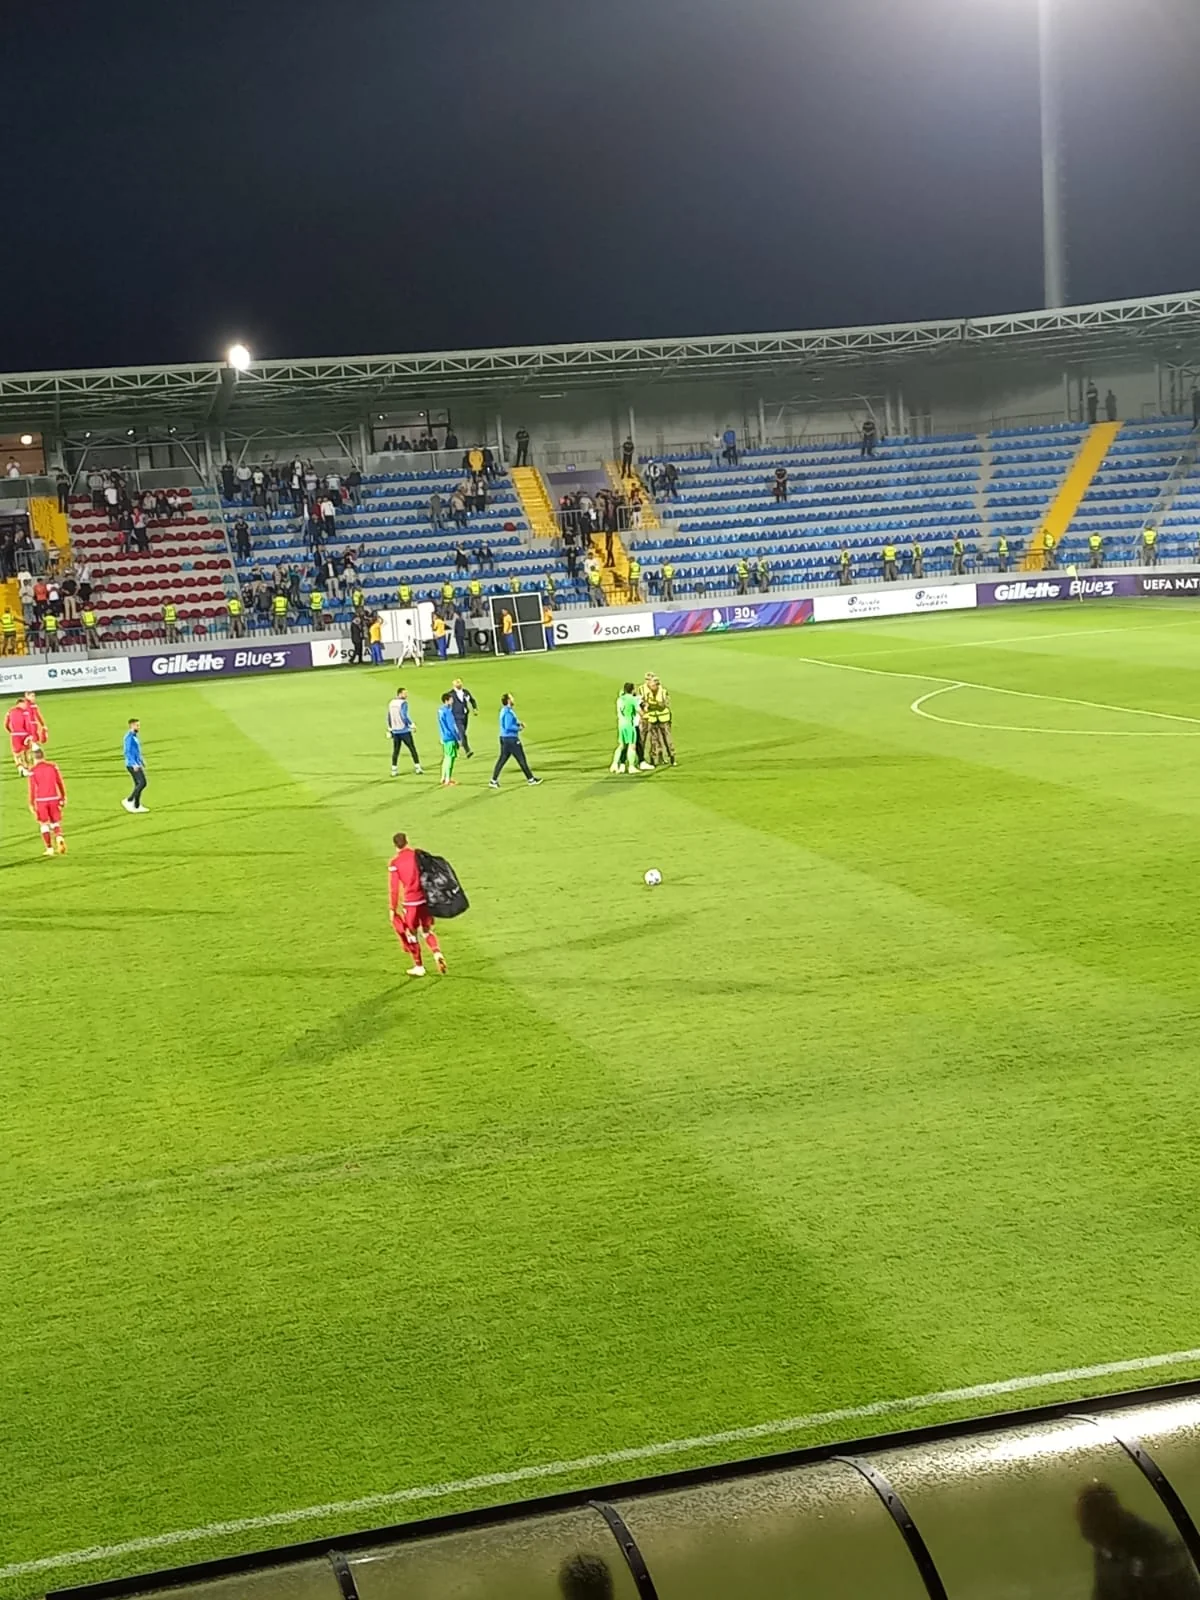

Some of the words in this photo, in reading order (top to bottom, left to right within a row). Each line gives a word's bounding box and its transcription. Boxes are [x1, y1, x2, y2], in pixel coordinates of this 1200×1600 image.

[994, 581, 1060, 601] Gillette
[1069, 580, 1115, 596] Blue3
[1143, 578, 1173, 590] UEFA
[1175, 577, 1199, 589] NAT
[604, 624, 641, 636] SOCAR
[151, 653, 225, 675] Gillette
[234, 651, 287, 668] Blue3
